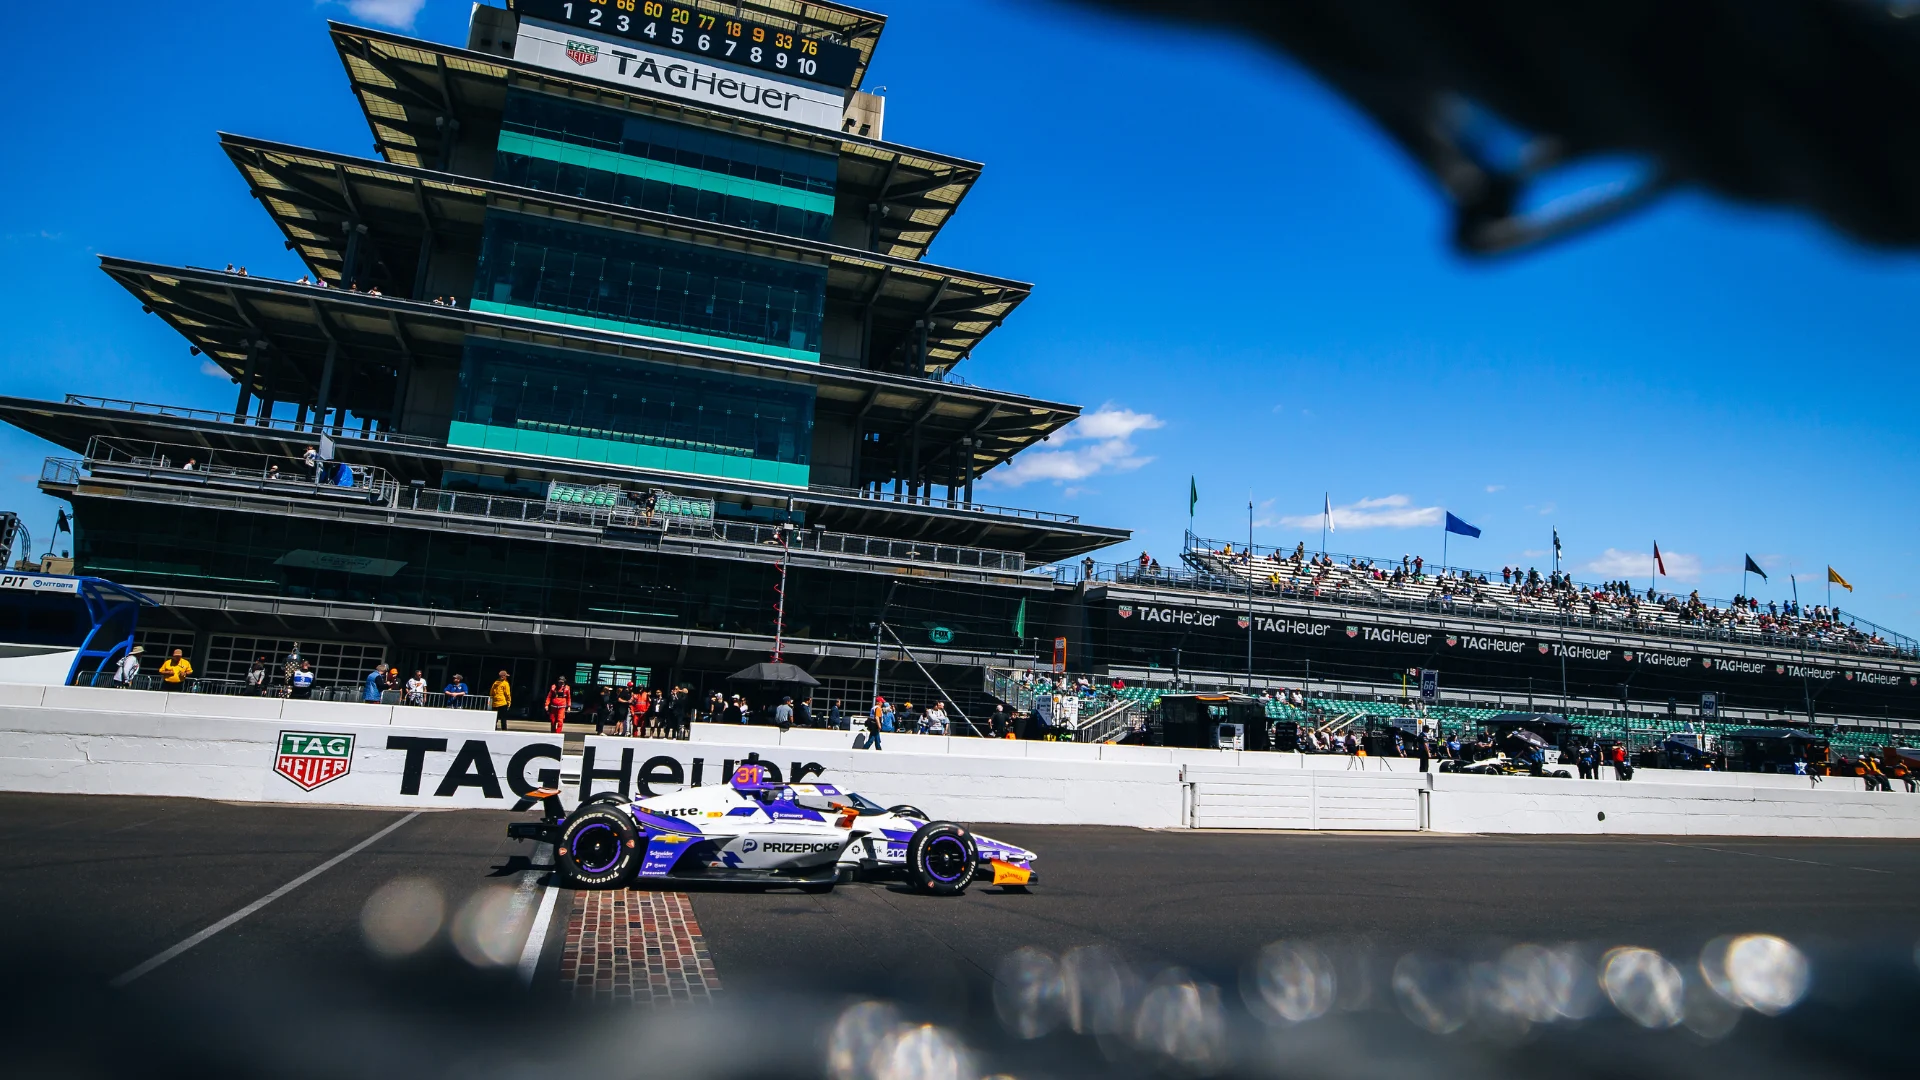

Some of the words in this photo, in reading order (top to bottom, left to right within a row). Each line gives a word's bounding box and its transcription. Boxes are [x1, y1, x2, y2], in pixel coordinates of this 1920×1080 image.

[644, 1, 663, 18] 60
[671, 8, 689, 25] 20
[698, 13, 716, 30] 77
[725, 21, 742, 37] 18
[752, 27, 765, 43] 9
[775, 33, 792, 49] 33
[801, 39, 818, 55] 76
[563, 3, 573, 19] 1
[588, 8, 603, 26] 2
[616, 15, 630, 32] 3
[643, 22, 657, 39] 4
[671, 27, 684, 44] 5
[697, 34, 711, 51] 6
[725, 39, 737, 56] 7
[749, 46, 763, 63] 8
[775, 52, 788, 69] 9
[797, 58, 817, 75] 10
[569, 41, 598, 54] TAG
[567, 50, 597, 64] HEUER
[1, 576, 29, 588] PIT
[1423, 680, 1435, 691] 66
[286, 736, 346, 755] TAG
[280, 758, 345, 786] HEUER
[736, 766, 758, 784] 31
[762, 842, 840, 853] PRIZEPICKS
[576, 871, 620, 884] Firestone
